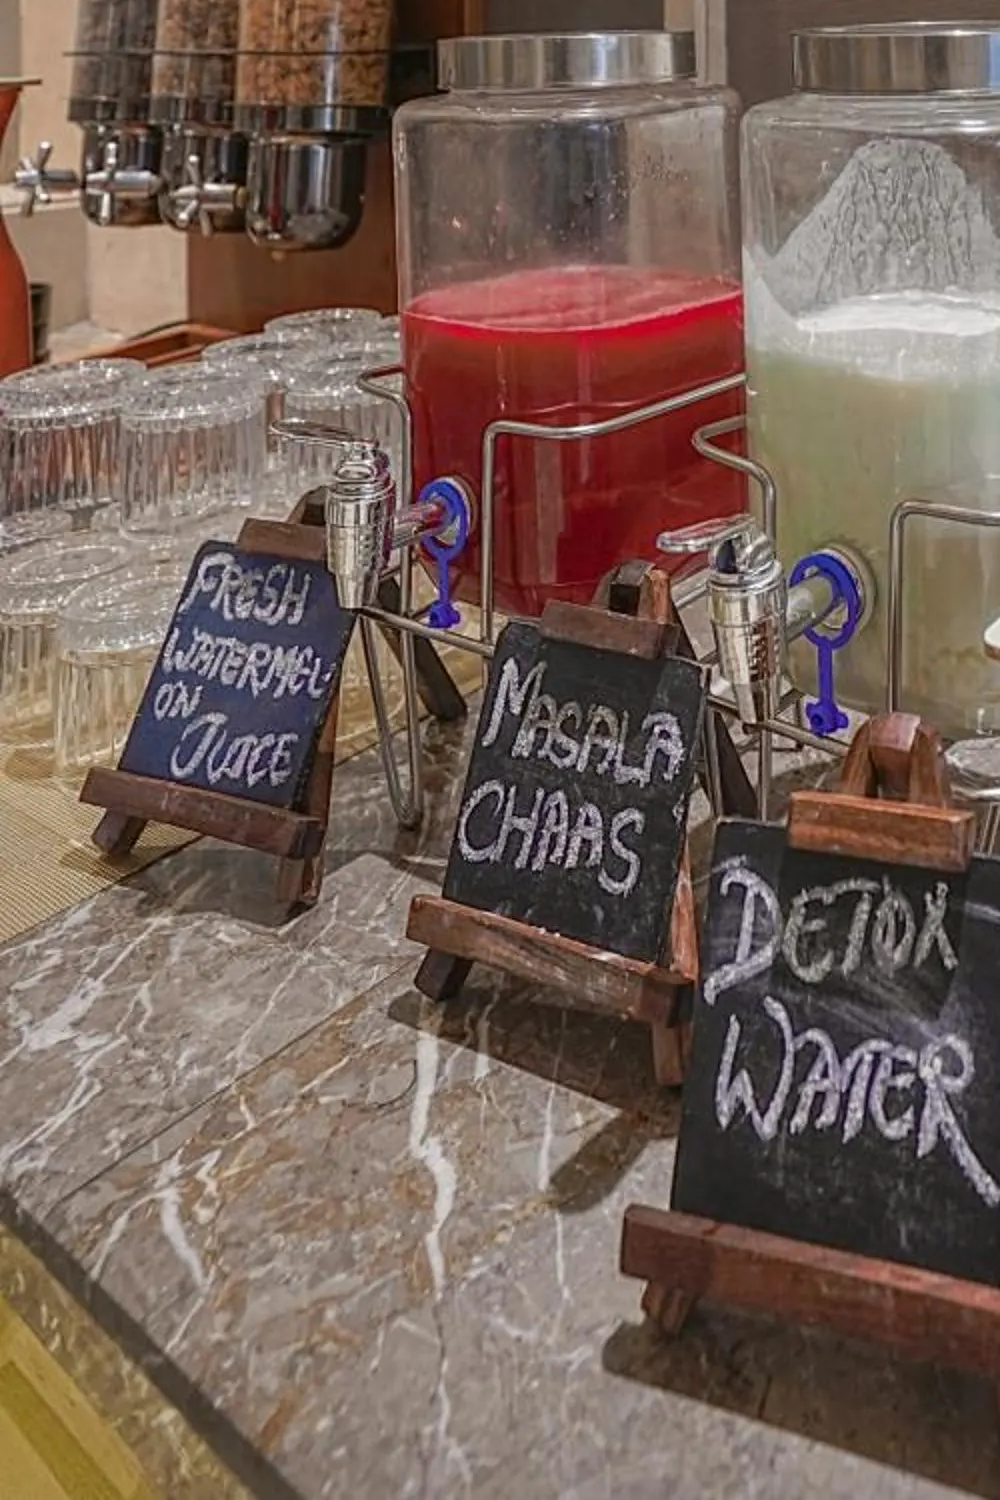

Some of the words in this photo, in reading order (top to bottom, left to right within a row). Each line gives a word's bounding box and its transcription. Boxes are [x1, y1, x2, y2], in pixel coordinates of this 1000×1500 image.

[179, 552, 312, 626] FRESH
[153, 681, 204, 720] ON
[482, 656, 686, 787] MASALA
[170, 712, 300, 788] JUICE
[457, 778, 645, 897] CHAAS
[703, 854, 959, 1006] DETOX
